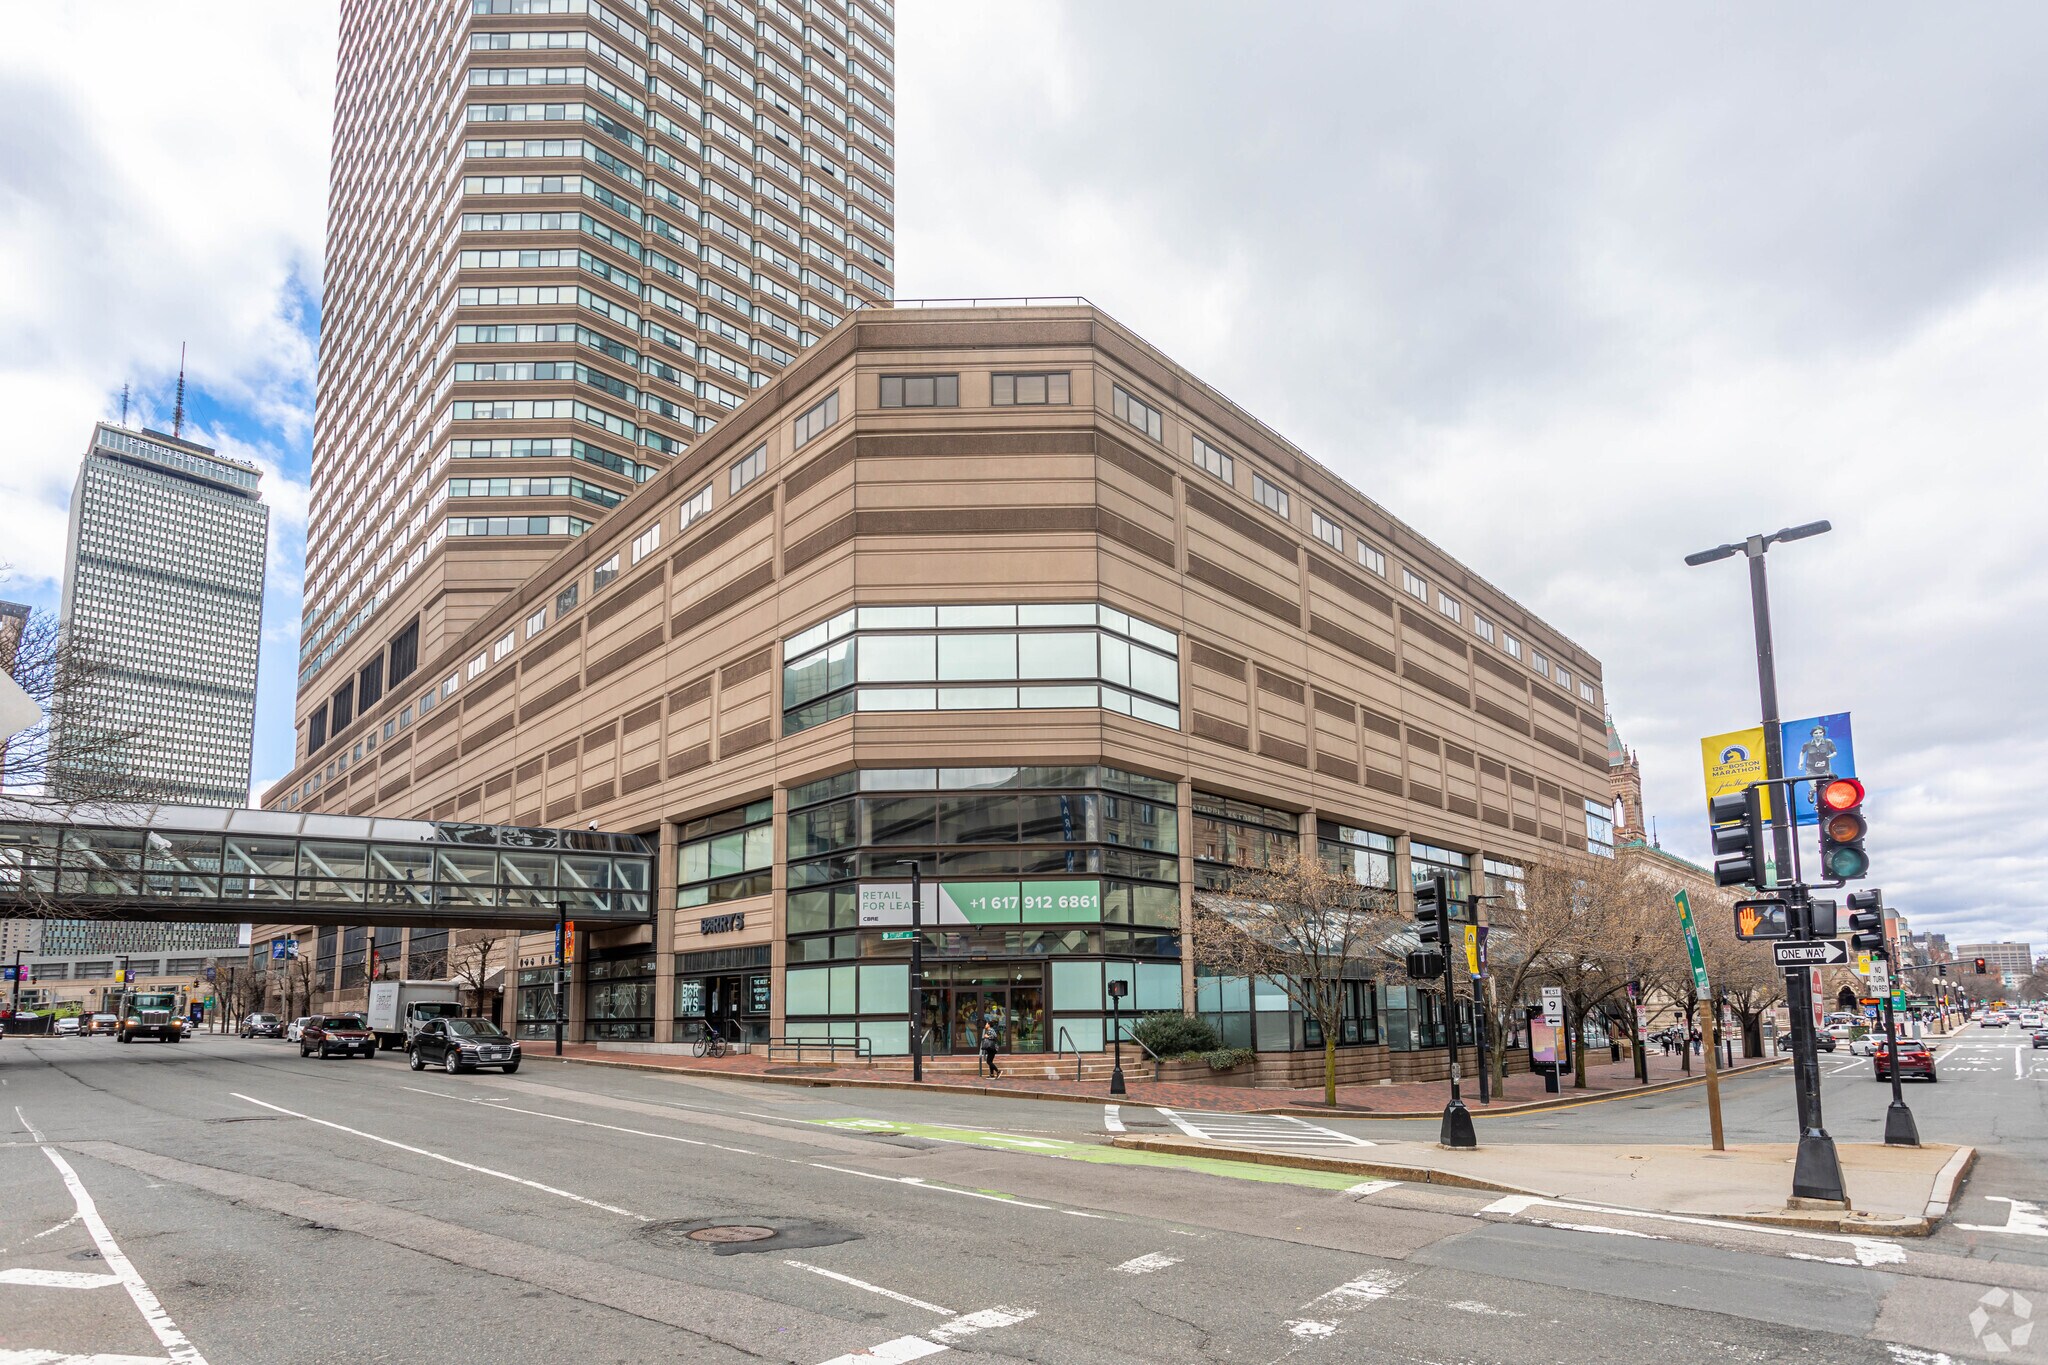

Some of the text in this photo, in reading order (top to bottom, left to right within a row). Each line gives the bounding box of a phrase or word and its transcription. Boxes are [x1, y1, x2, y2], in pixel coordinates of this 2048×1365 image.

[1729, 761, 1760, 769] BOSTON
[1712, 766, 1760, 776] MARATHON
[862, 892, 901, 900] RETAIL
[862, 901, 925, 910] FOR LEAE
[970, 896, 1098, 910] +1 617 912 6861
[701, 912, 744, 935] BARRY'S
[1782, 948, 1825, 959] ONE WAY
[683, 983, 699, 997] BAR
[1549, 1001, 1556, 1010] 9
